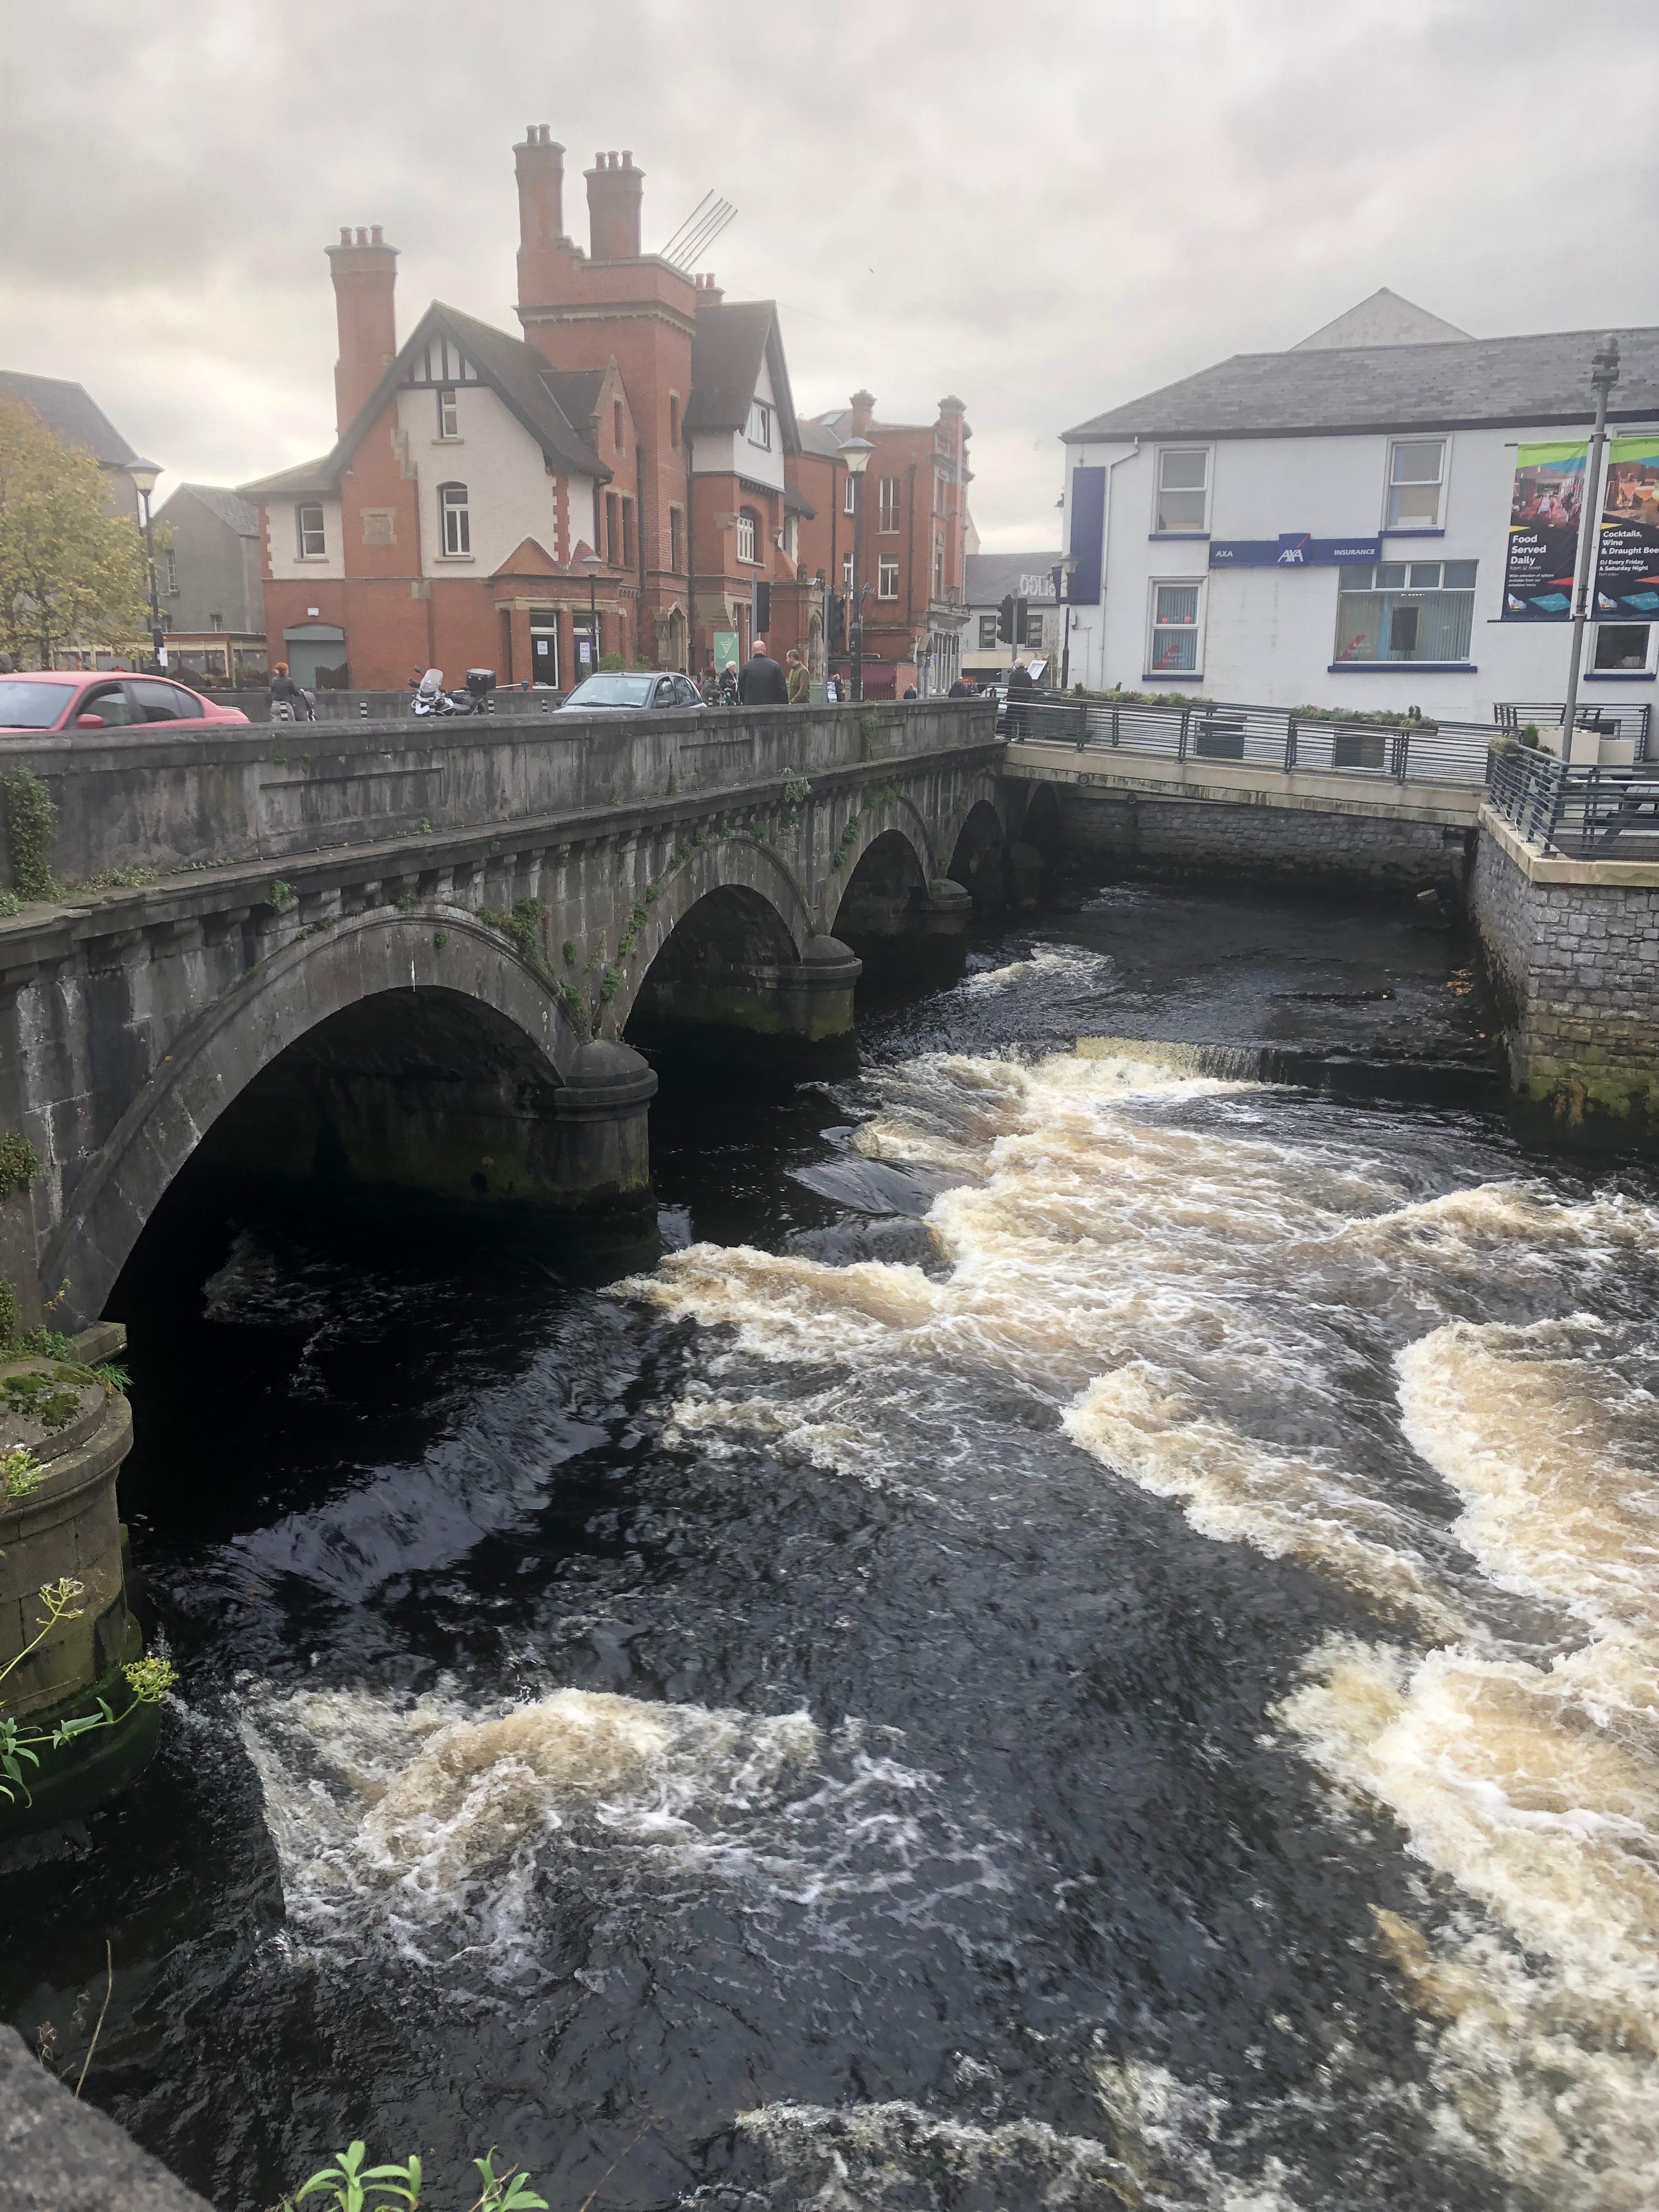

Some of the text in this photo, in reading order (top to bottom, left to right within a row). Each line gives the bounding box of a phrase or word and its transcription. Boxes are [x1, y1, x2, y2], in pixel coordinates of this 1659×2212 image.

[1513, 534, 1538, 543] Food
[1511, 545, 1547, 554] Served
[1609, 547, 1642, 556] Draught
[1277, 549, 1304, 562] AXA
[1510, 556, 1536, 566] Daily
